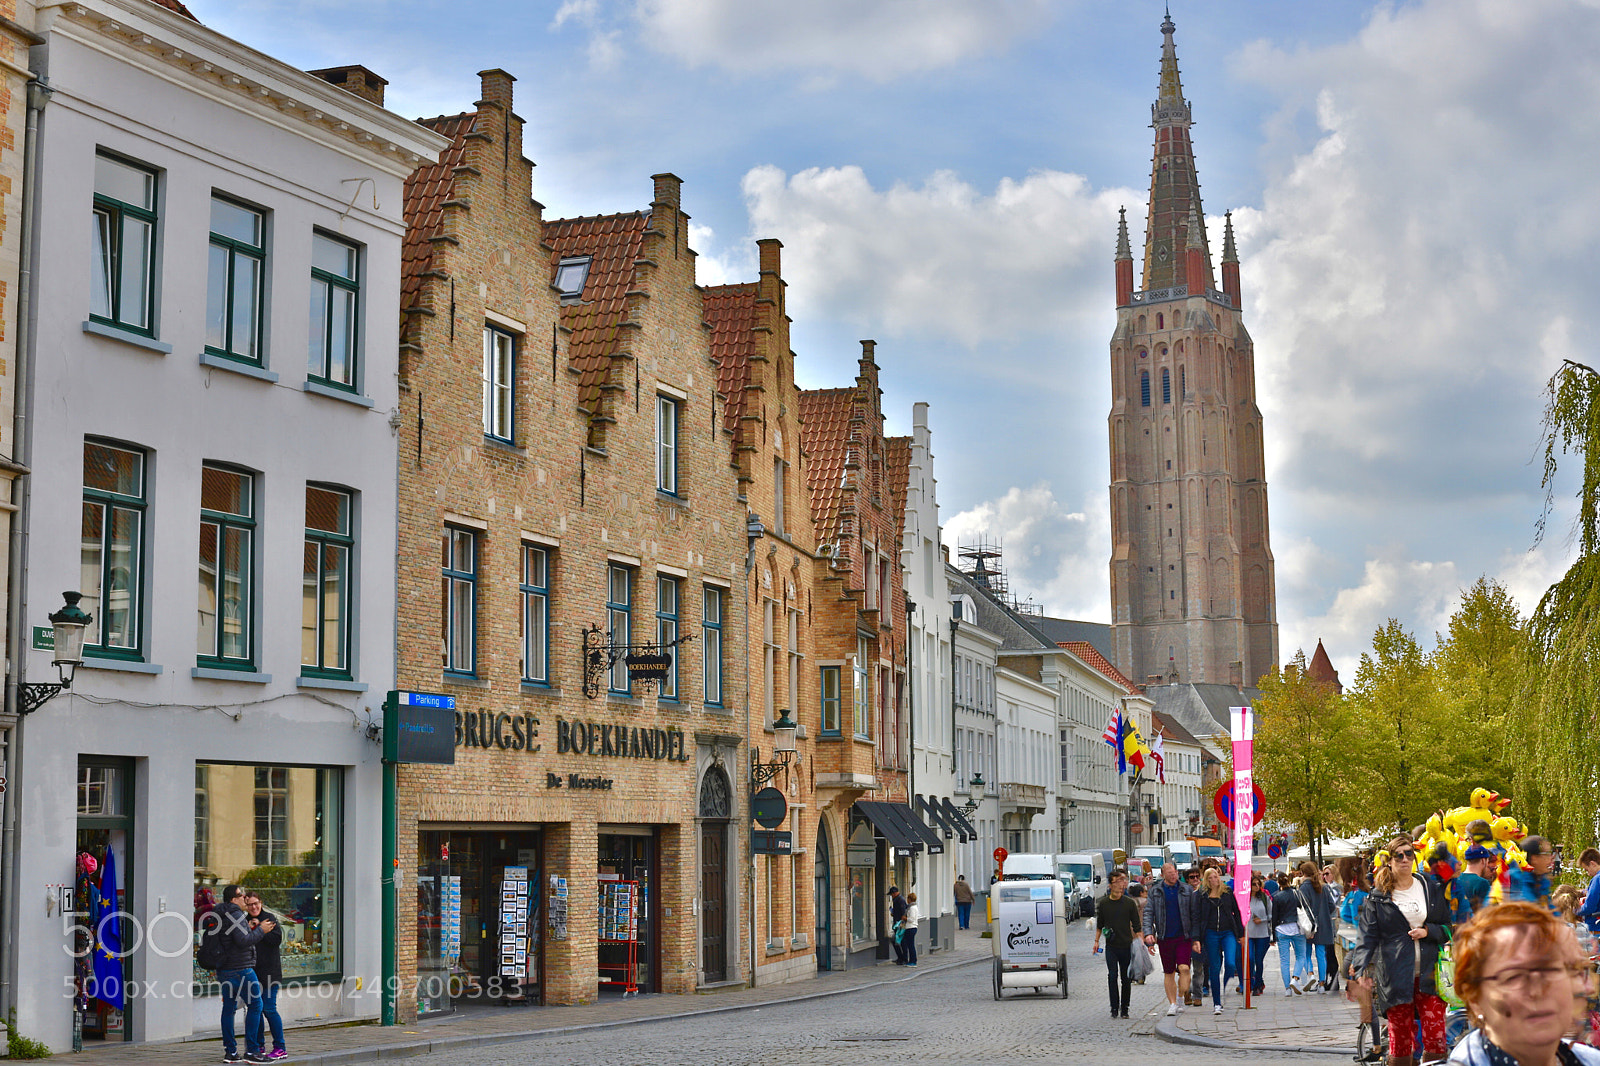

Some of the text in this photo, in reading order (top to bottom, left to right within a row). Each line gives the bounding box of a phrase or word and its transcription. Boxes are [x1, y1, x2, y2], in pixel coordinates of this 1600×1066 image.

[628, 663, 669, 671] BOEKHANDEL
[415, 694, 440, 708] Parking
[455, 709, 690, 761] BRUGSE BOEKHANDEL
[547, 773, 562, 789] De
[66, 892, 71, 908] 1
